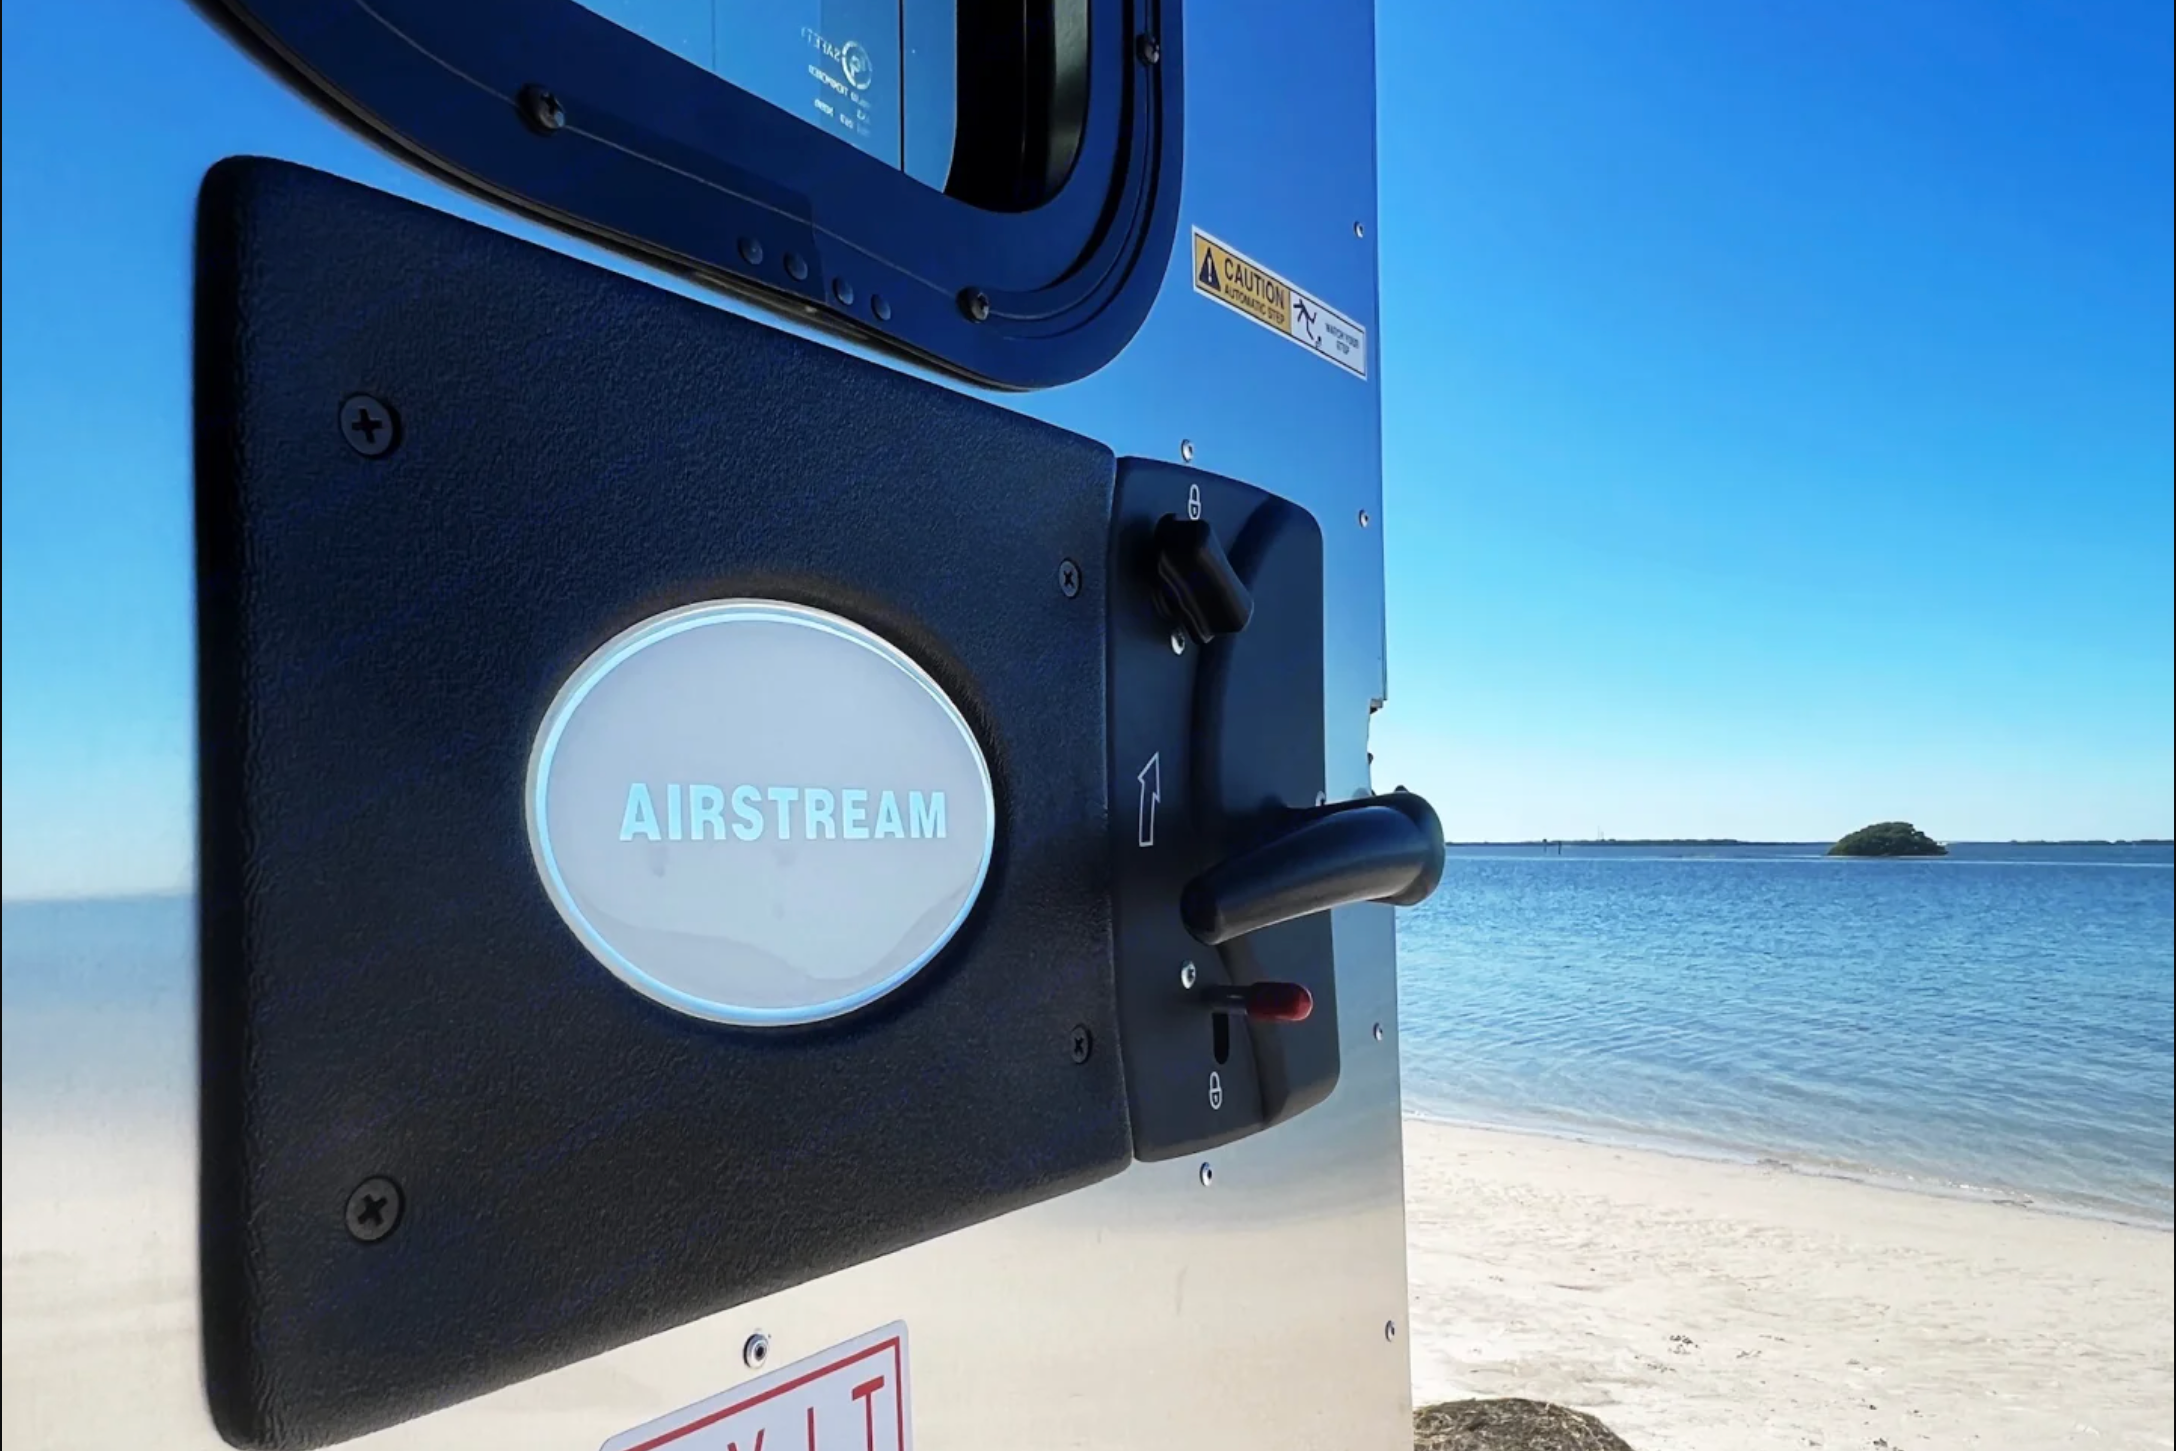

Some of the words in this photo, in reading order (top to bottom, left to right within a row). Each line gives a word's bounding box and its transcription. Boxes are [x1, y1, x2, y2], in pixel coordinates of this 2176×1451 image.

[1224, 257, 1285, 310] CAUTION
[1224, 285, 1267, 316] AUTOMATIC
[1268, 307, 1285, 325] STEP
[619, 782, 947, 842] AIRSTREAM
